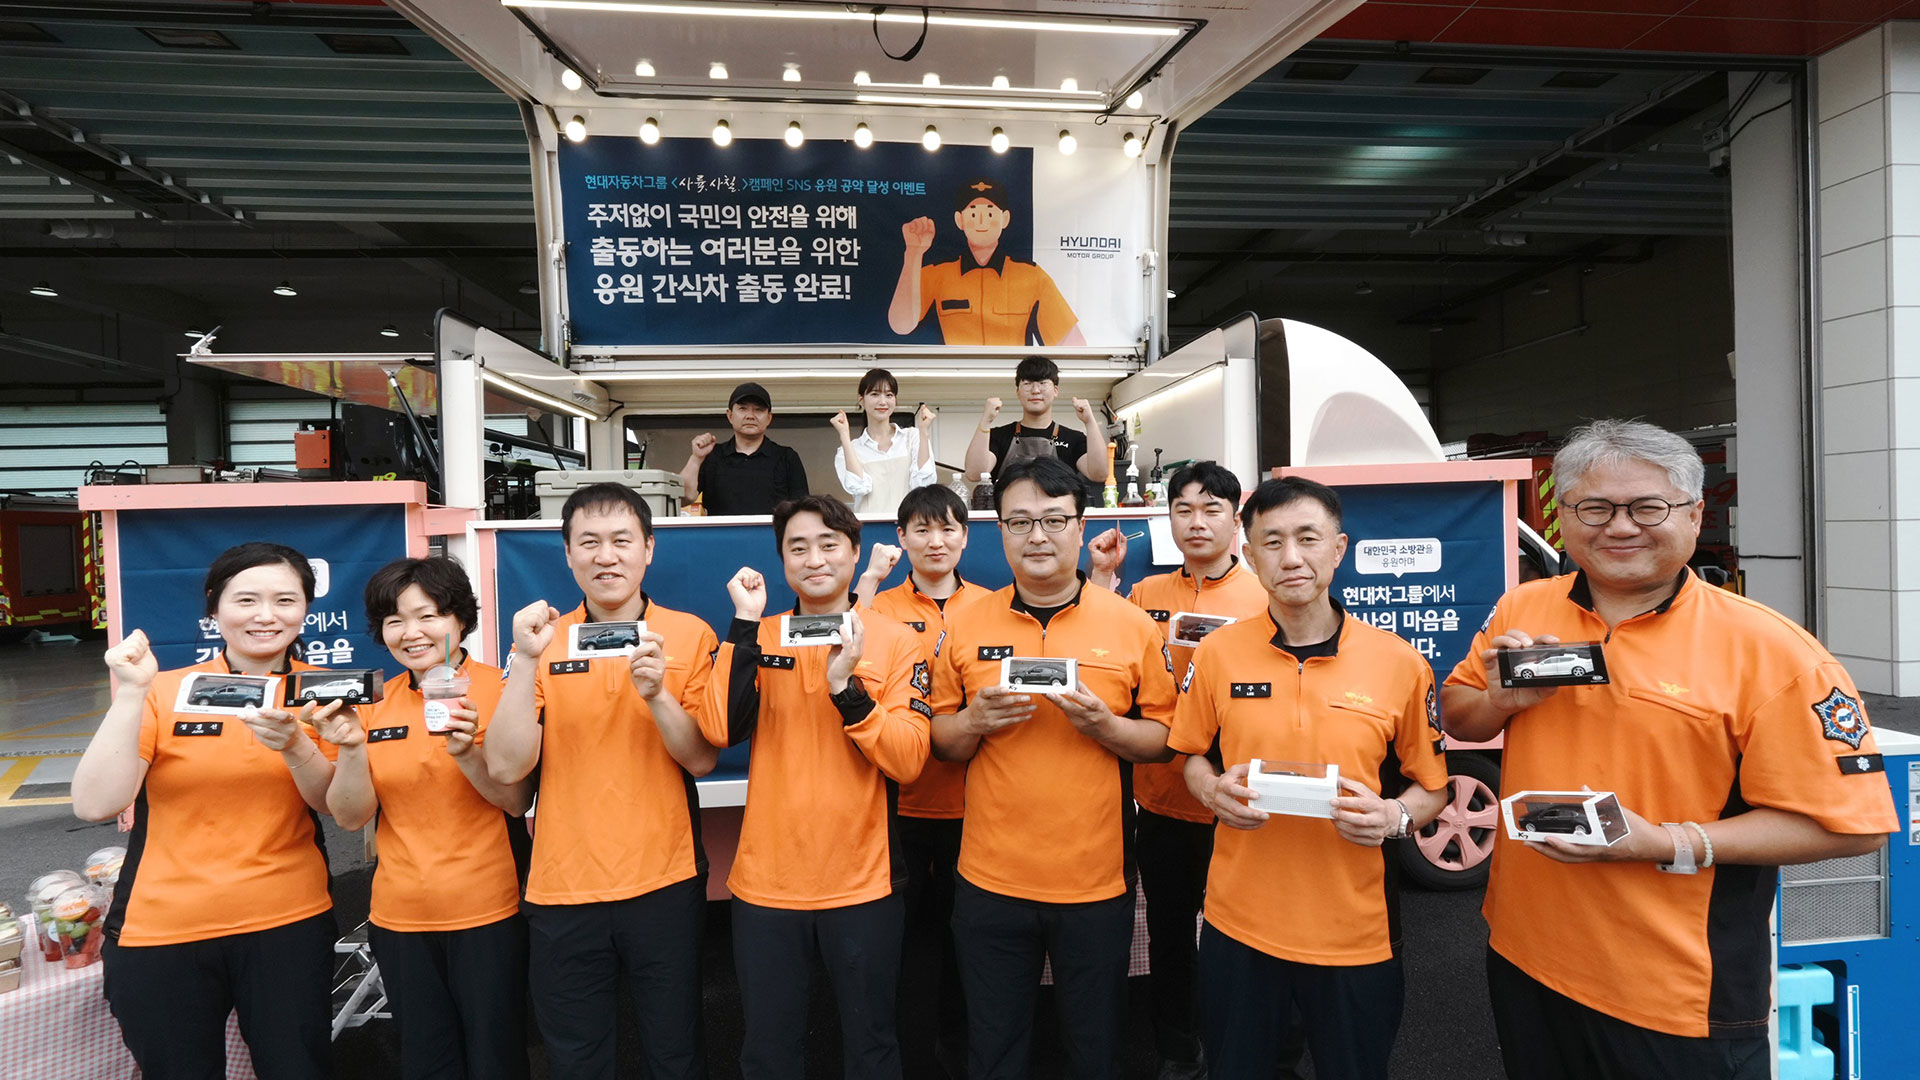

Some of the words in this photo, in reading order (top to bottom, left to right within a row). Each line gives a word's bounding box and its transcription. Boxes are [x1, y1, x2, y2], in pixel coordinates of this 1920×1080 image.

[584, 175, 668, 190] 현대자동차그룹
[786, 179, 812, 192] SNS
[814, 178, 837, 192] 응원
[840, 179, 865, 193] 공약
[867, 180, 889, 195] 달성
[892, 181, 927, 196] 이벤트
[587, 203, 671, 229] 주저없이
[678, 205, 742, 229] 국민의
[748, 204, 810, 229] 안전을
[815, 206, 857, 229] 위해
[590, 237, 694, 267] 출동하는
[701, 237, 803, 266] 여러분을
[811, 238, 862, 266] 위한
[1060, 236, 1121, 249] HYUNDAI
[592, 274, 645, 305] 응원
[652, 274, 730, 304] 간식차
[736, 274, 787, 304] 출동
[793, 274, 851, 301] 완료!
[1363, 545, 1397, 556] 대한민국
[1399, 543, 1433, 555] 소방관을
[1382, 557, 1416, 568] 응원하며
[1342, 584, 1456, 606] 현대차그룹에서
[1349, 610, 1397, 632] 사의
[1403, 608, 1460, 632] 마음을
[305, 638, 355, 665] 음을
